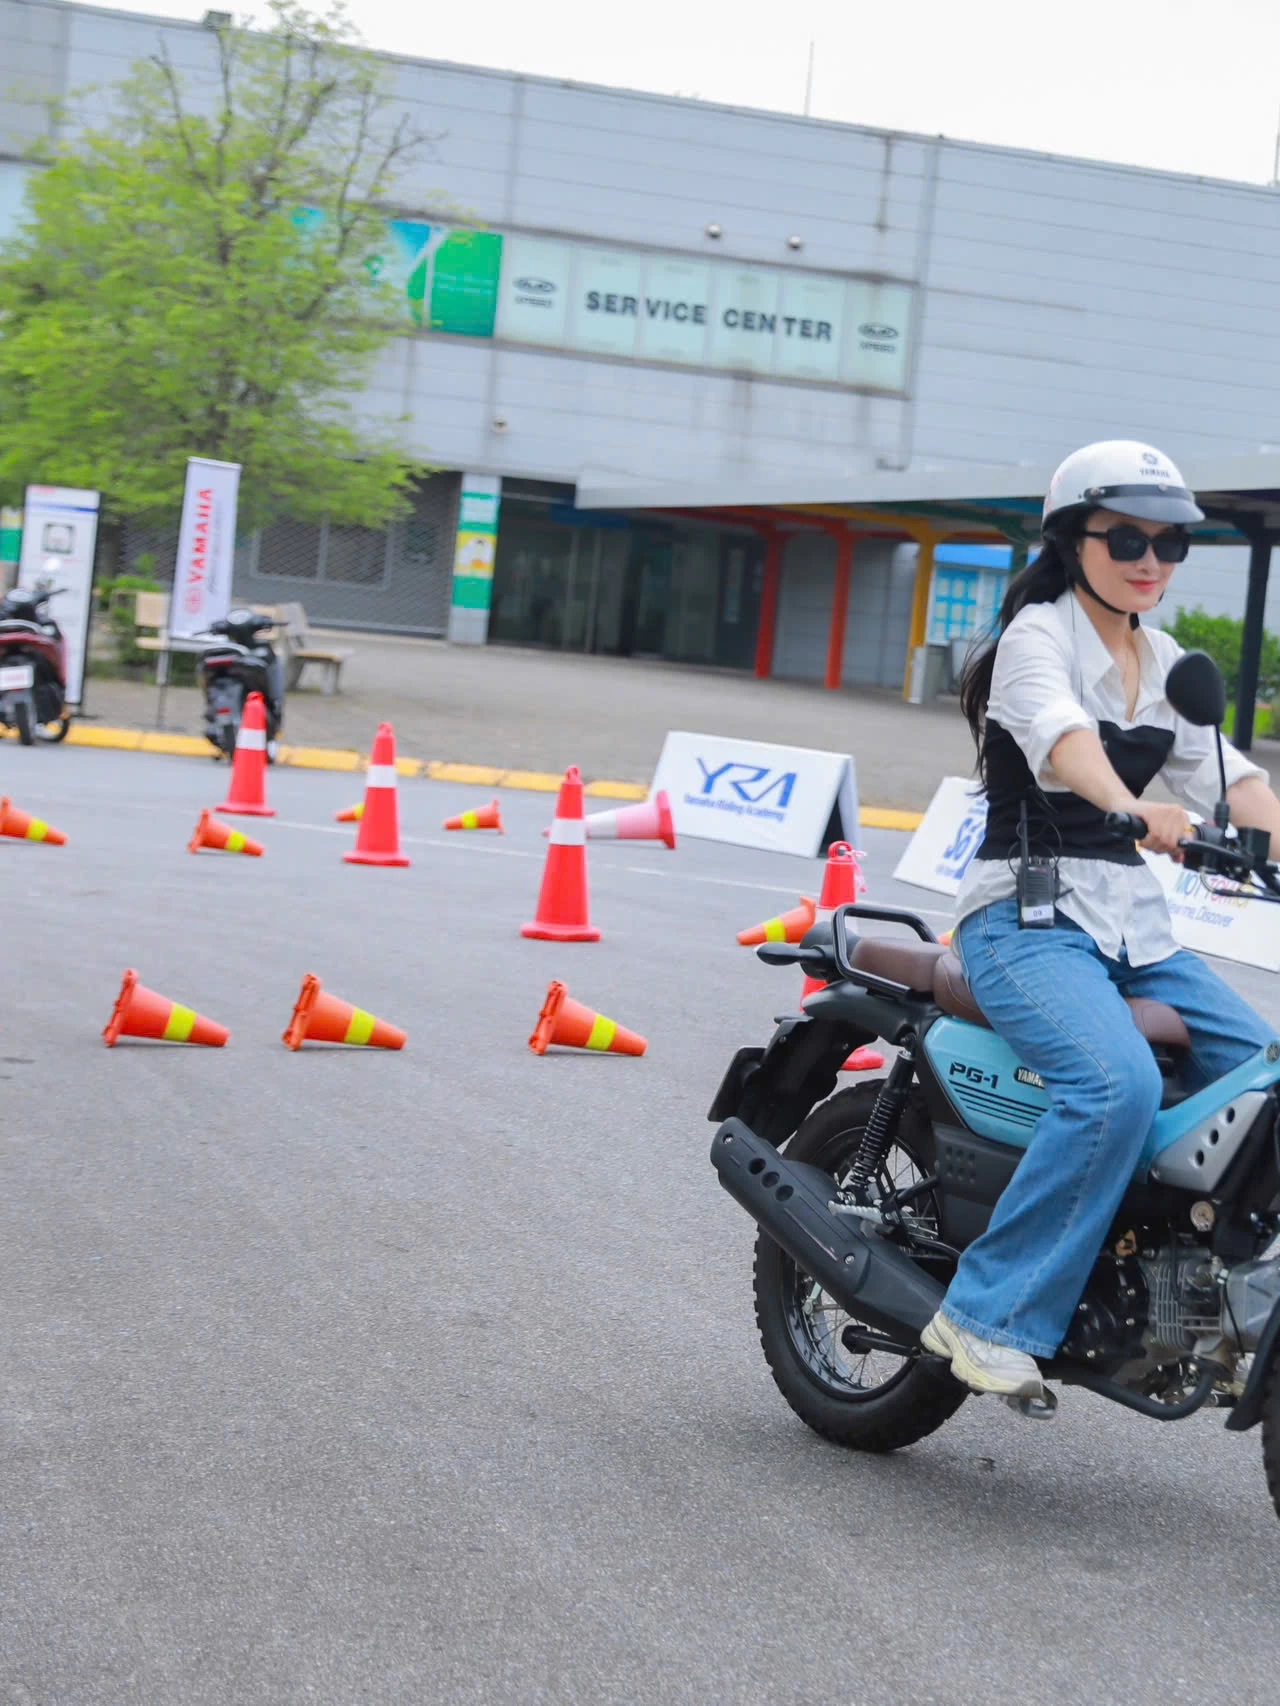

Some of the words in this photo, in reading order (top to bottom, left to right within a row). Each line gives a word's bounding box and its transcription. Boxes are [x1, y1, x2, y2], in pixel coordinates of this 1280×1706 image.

[586, 291, 707, 325] SERVICE
[723, 308, 833, 342] CENTER
[187, 488, 214, 584] YAMAHA
[696, 757, 796, 808] YRA
[950, 1061, 999, 1089] PG-1
[1017, 1068, 1045, 1088] YAMA
